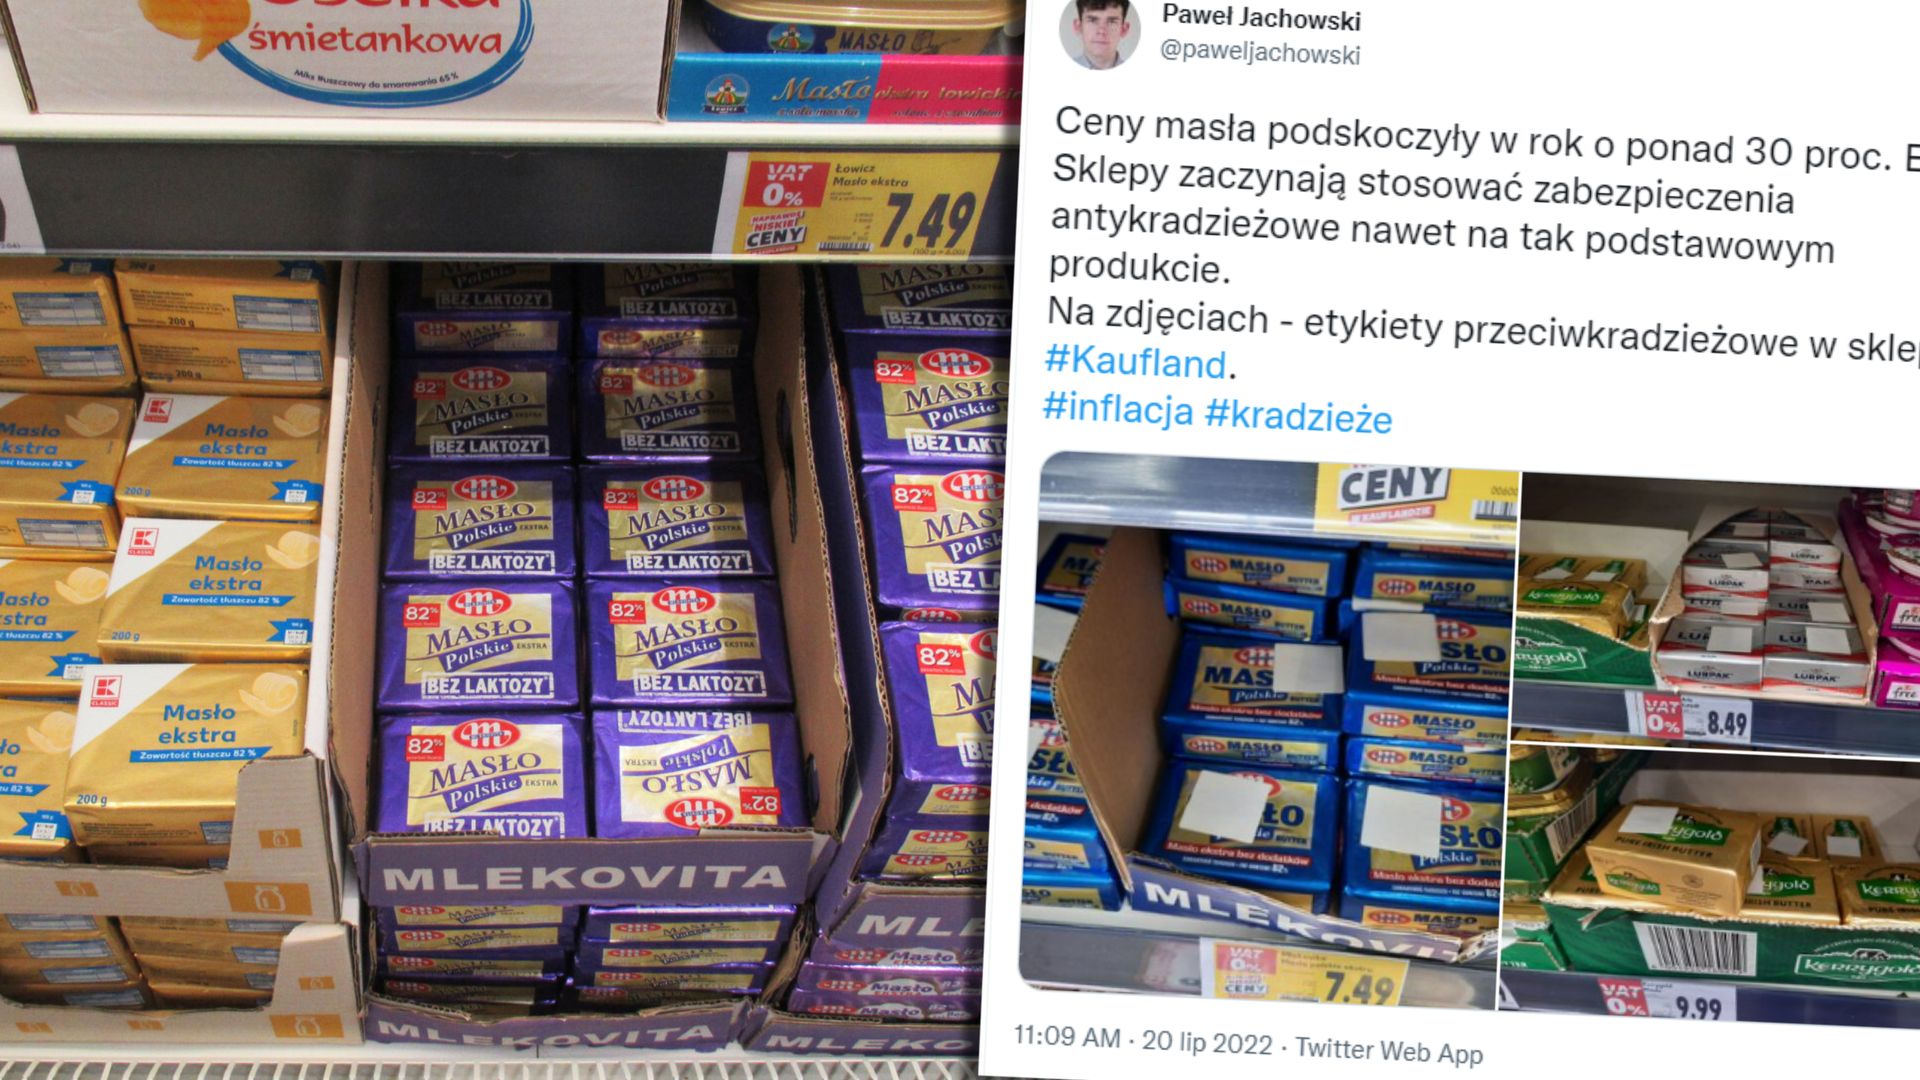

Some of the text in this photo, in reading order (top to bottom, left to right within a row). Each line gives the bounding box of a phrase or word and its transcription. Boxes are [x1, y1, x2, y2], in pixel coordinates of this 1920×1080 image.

[248, 22, 501, 53] śmietankowa
[839, 34, 906, 51] MASŁO
[294, 69, 315, 81] Miks
[771, 74, 871, 101] Masło
[768, 164, 813, 181] VAT
[835, 164, 875, 173] Łowicz
[833, 177, 908, 187] Masło ekstra
[762, 183, 803, 206] 0%
[754, 220, 795, 230] NISKIE
[880, 191, 977, 248] 7.49
[747, 228, 803, 246] CENY
[440, 294, 542, 306] BEZ LAKTOZY
[901, 281, 965, 305] Polskie
[625, 301, 727, 315] BEZ LAKTOZY
[167, 317, 186, 326] 200
[889, 312, 924, 326] BEZ
[876, 363, 912, 378] 82%
[435, 392, 529, 421] MASŁO
[623, 388, 715, 416] MASŁO
[450, 409, 510, 434] Polskie
[639, 405, 697, 429] Polskie
[927, 402, 996, 428] Polskie
[0, 424, 60, 438] Masło
[205, 424, 269, 438] Masło
[200, 441, 267, 455] ekstra
[435, 440, 539, 454] BEZ LAKTOZY
[627, 435, 729, 448] BEZ LAKTOZY
[913, 436, 951, 452] BEZ
[182, 457, 225, 467] Zawartość
[228, 459, 260, 468] tłuszczu
[125, 487, 143, 495] 200
[1341, 467, 1443, 503] CENY
[414, 490, 446, 504] 82%
[605, 490, 637, 504] 82%
[894, 488, 932, 504] 82%
[434, 502, 535, 534] MASŁO
[627, 502, 726, 535] MASŁO
[451, 521, 514, 549] Polskie
[644, 523, 707, 550] Polskie
[195, 556, 263, 571] Masło
[434, 554, 545, 570] BEZ LAKTOZY
[631, 555, 742, 570] BEZ LAKTOZY
[1229, 559, 1285, 574] MASŁO
[190, 576, 262, 591] ekstra
[935, 570, 973, 587] BEZ
[1418, 580, 1475, 593] MASŁO
[171, 595, 218, 604] Zawartość
[220, 596, 256, 604] tłuszczu
[405, 605, 439, 620] 82%
[611, 603, 644, 617] 82%
[1220, 602, 1272, 619] MASŁO
[112, 632, 131, 640] 200
[426, 618, 532, 656] MASŁO
[635, 617, 739, 652] MASŁO
[444, 640, 547, 672] Polskie EKSTRA
[653, 638, 719, 667] Polskie
[919, 648, 961, 666] 82%
[639, 675, 754, 691] BEZ LAKTOZY
[1687, 671, 1733, 679] LURPAK
[1794, 674, 1840, 682] LURPAK
[427, 678, 543, 694] BEZ LAKTOZY
[1894, 689, 1918, 698] free
[164, 704, 236, 721] Masło
[1646, 700, 1681, 714] VAT
[1412, 715, 1475, 729] MASŁO
[1648, 714, 1680, 733] 0%
[1708, 711, 1747, 736] 8.49
[159, 727, 236, 744] ekstra
[408, 738, 444, 754] 82%
[1227, 740, 1283, 753] MASŁO
[140, 749, 246, 760] Zawartość tłuszczu 82
[1409, 752, 1467, 765] MASŁO
[429, 752, 542, 793] MASŁO
[643, 755, 753, 794] MASŁO
[77, 795, 97, 804] 200
[449, 776, 558, 813] Polskie EKSTRA
[470, 817, 554, 837] LAKTOZY
[383, 865, 787, 891] MLEKOVITA
[1326, 971, 1395, 1005] 7.49
[1600, 984, 1642, 997] VAT
[1607, 998, 1646, 1015] 0%
[1676, 996, 1721, 1020] 9.99
[378, 1020, 714, 1047] MLEKOVITA
